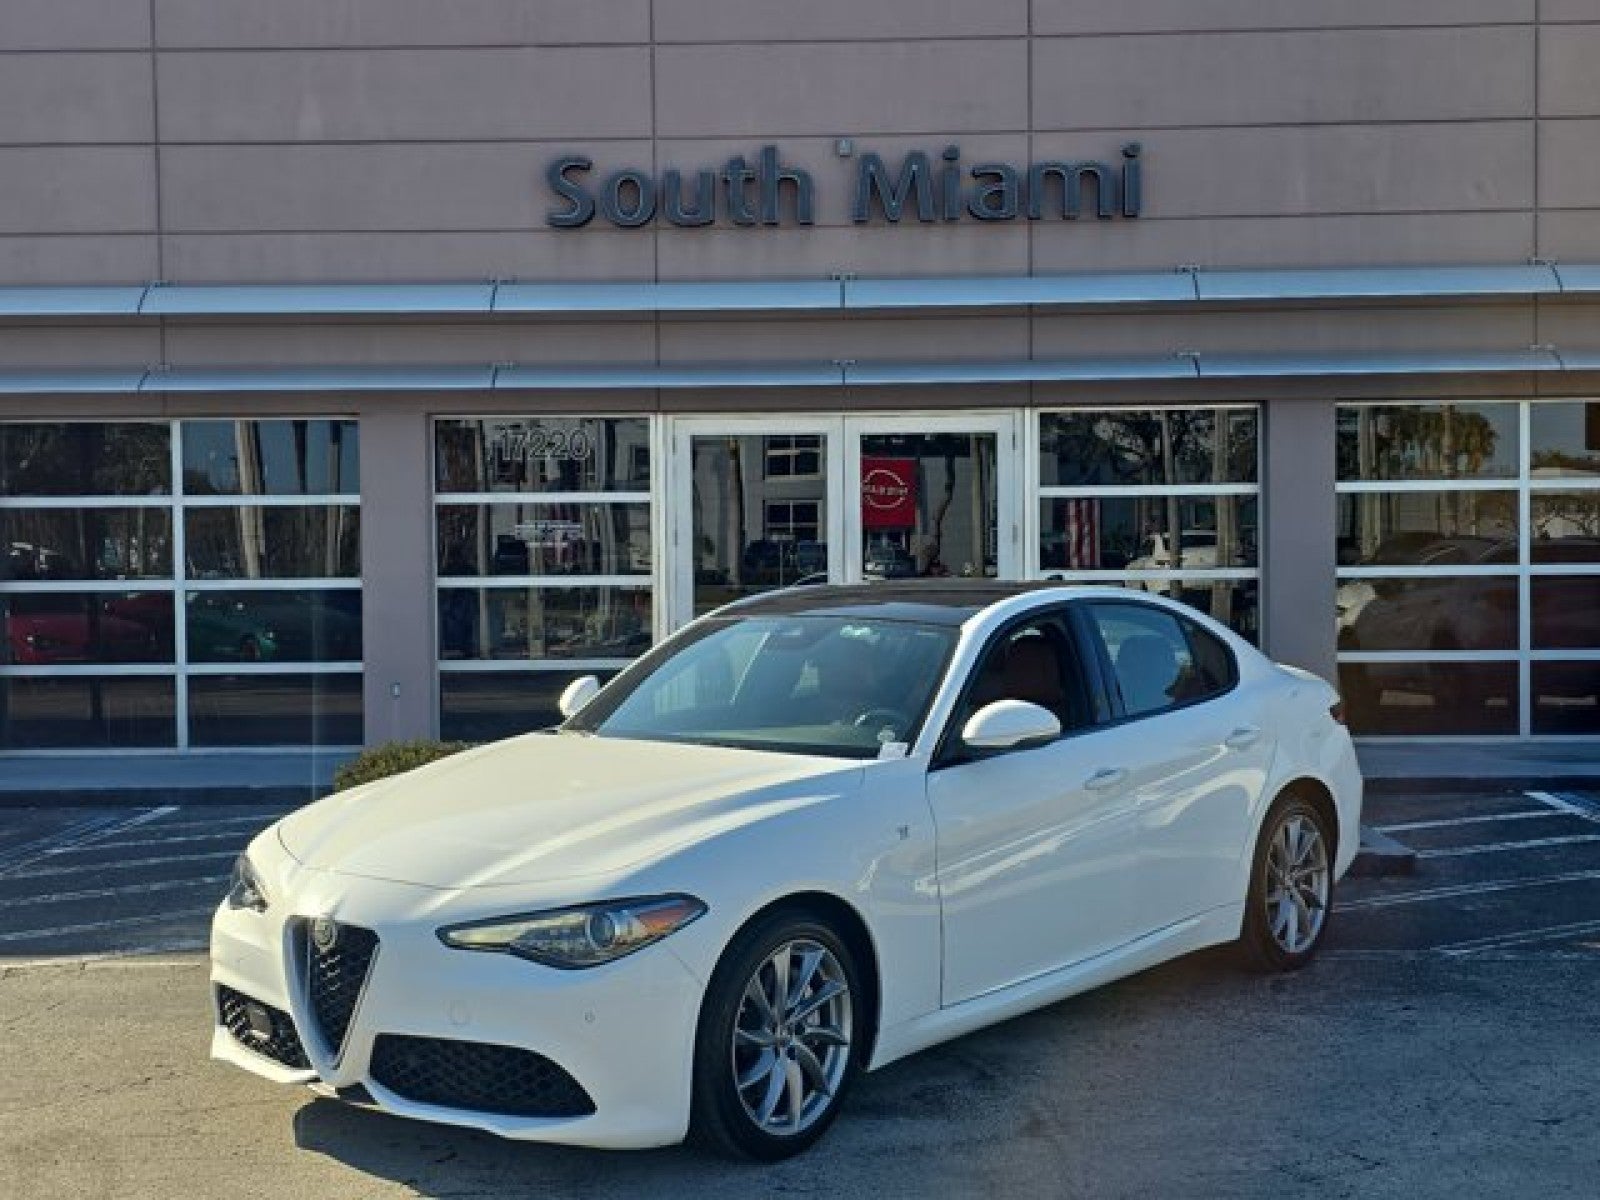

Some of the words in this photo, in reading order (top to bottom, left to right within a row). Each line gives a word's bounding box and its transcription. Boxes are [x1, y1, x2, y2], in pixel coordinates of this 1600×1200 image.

[545, 145, 815, 229] South
[850, 142, 1143, 223] Miami
[501, 429, 590, 461] 17220
